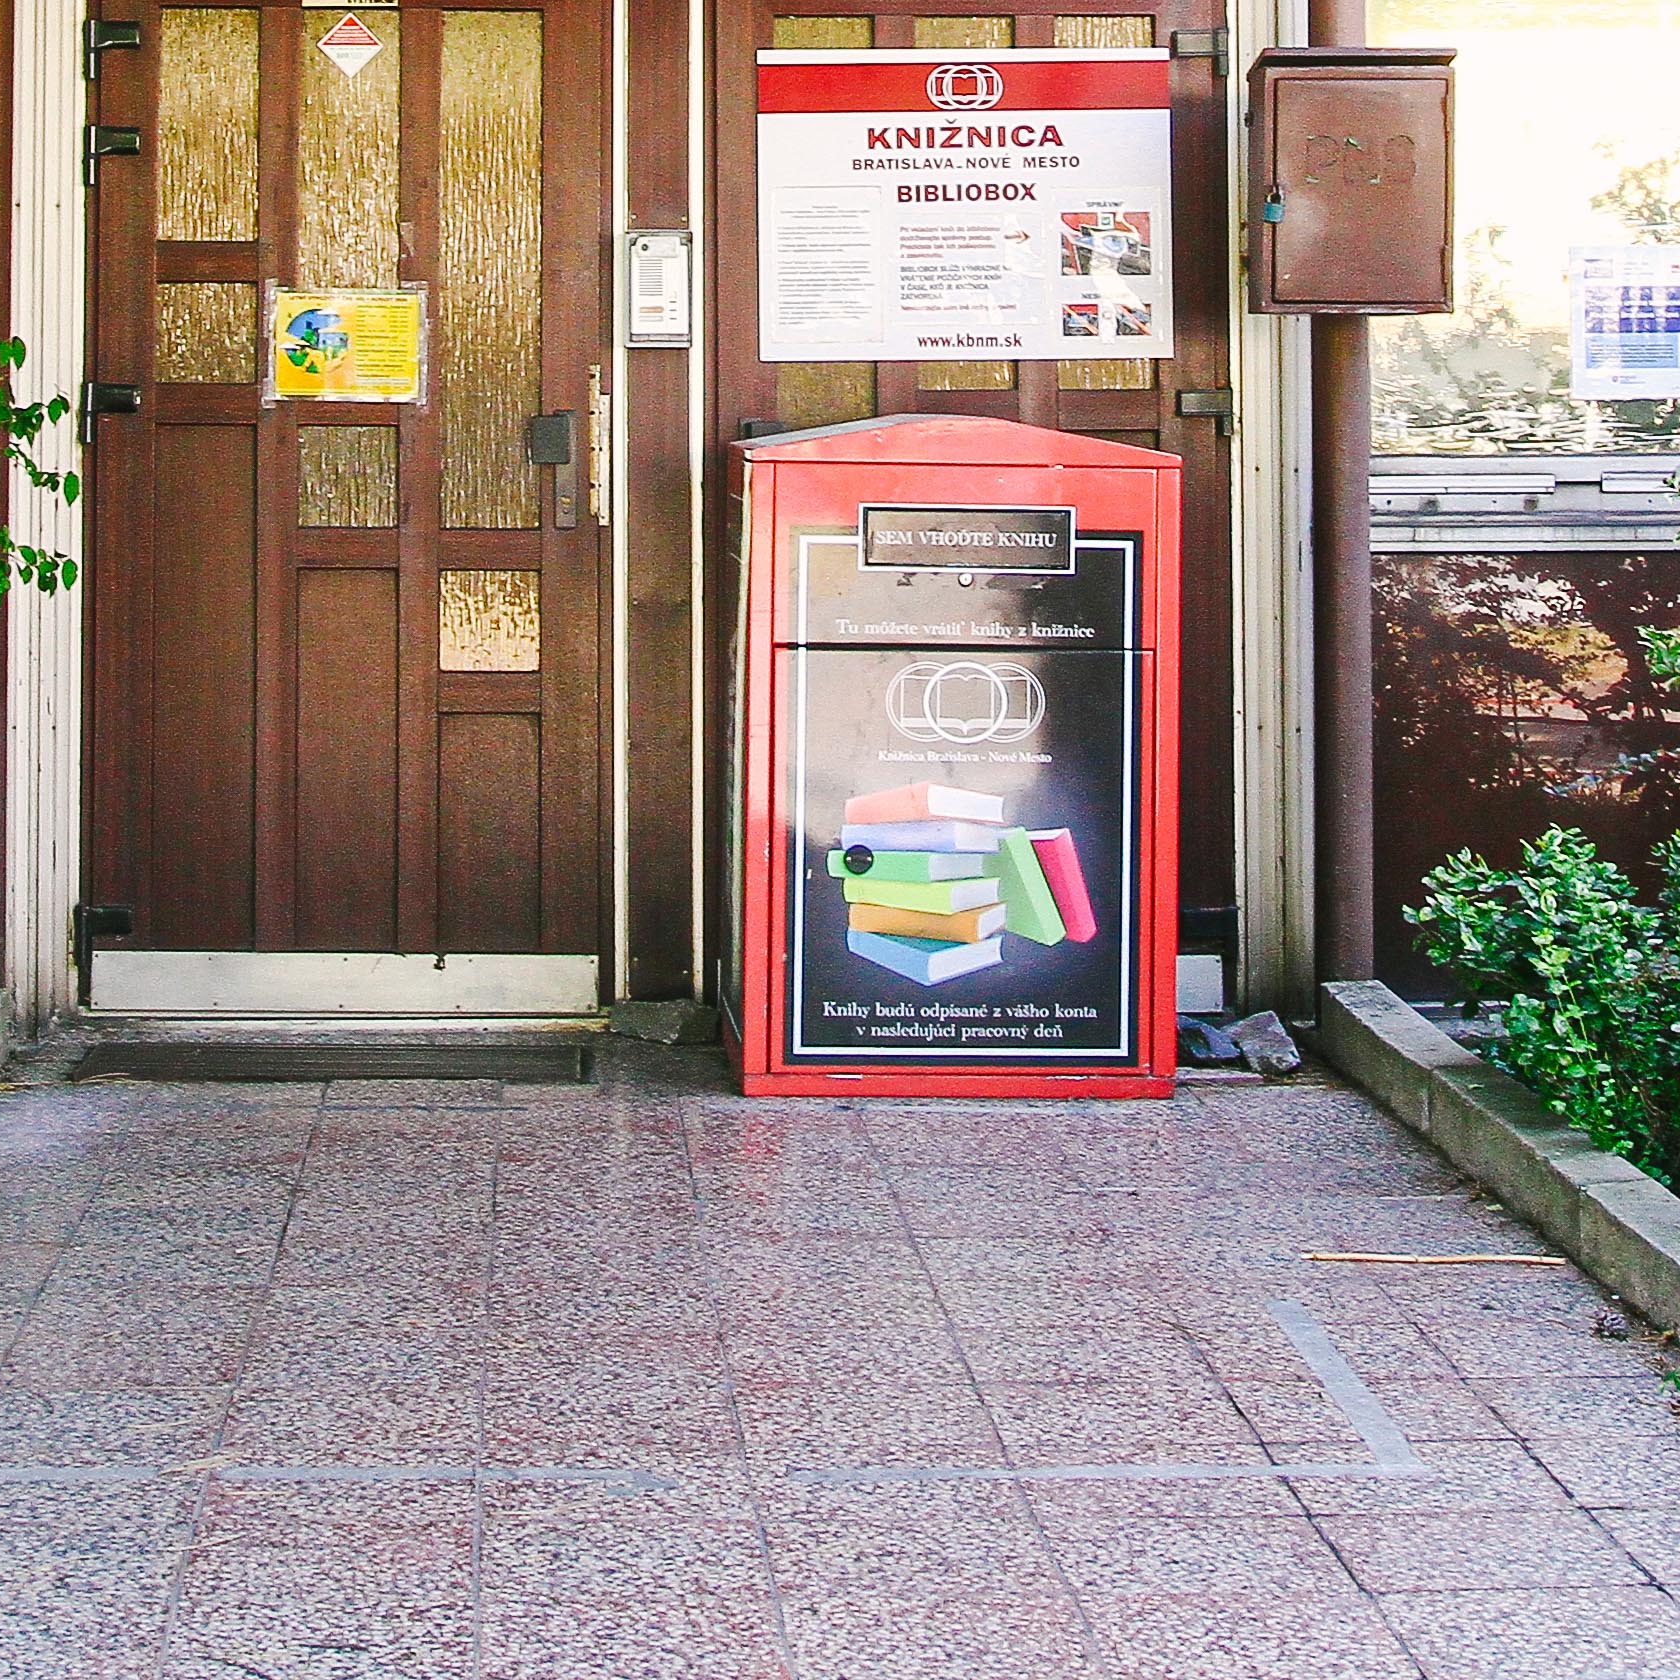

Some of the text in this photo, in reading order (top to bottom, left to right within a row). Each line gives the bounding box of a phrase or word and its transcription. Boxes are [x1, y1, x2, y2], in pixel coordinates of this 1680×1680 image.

[867, 119, 1064, 149] KNIŽNICA
[1023, 156, 1080, 168] MESTO
[897, 183, 1038, 203] BIBLIOBOX
[917, 333, 1022, 347] www.kbnm.sk
[875, 531, 913, 545] SEM
[998, 532, 1057, 548] KNIHU
[835, 619, 858, 635] Tu
[864, 620, 918, 636] môžete
[970, 621, 1013, 639] knihy
[1018, 626, 1027, 637] z
[1031, 622, 1096, 638] knižnice
[878, 750, 924, 762] Knižnica
[927, 750, 979, 762] Bratislava
[988, 751, 1017, 762] Nové
[1019, 752, 1053, 763] Mesto
[822, 1001, 871, 1019] Knihy
[875, 1002, 915, 1018] budú
[992, 1008, 1001, 1018] z
[1005, 1003, 1050, 1018] vášho
[1055, 1004, 1097, 1018] konta
[856, 1022, 1063, 1041] v nasledujúci pracovný deň
